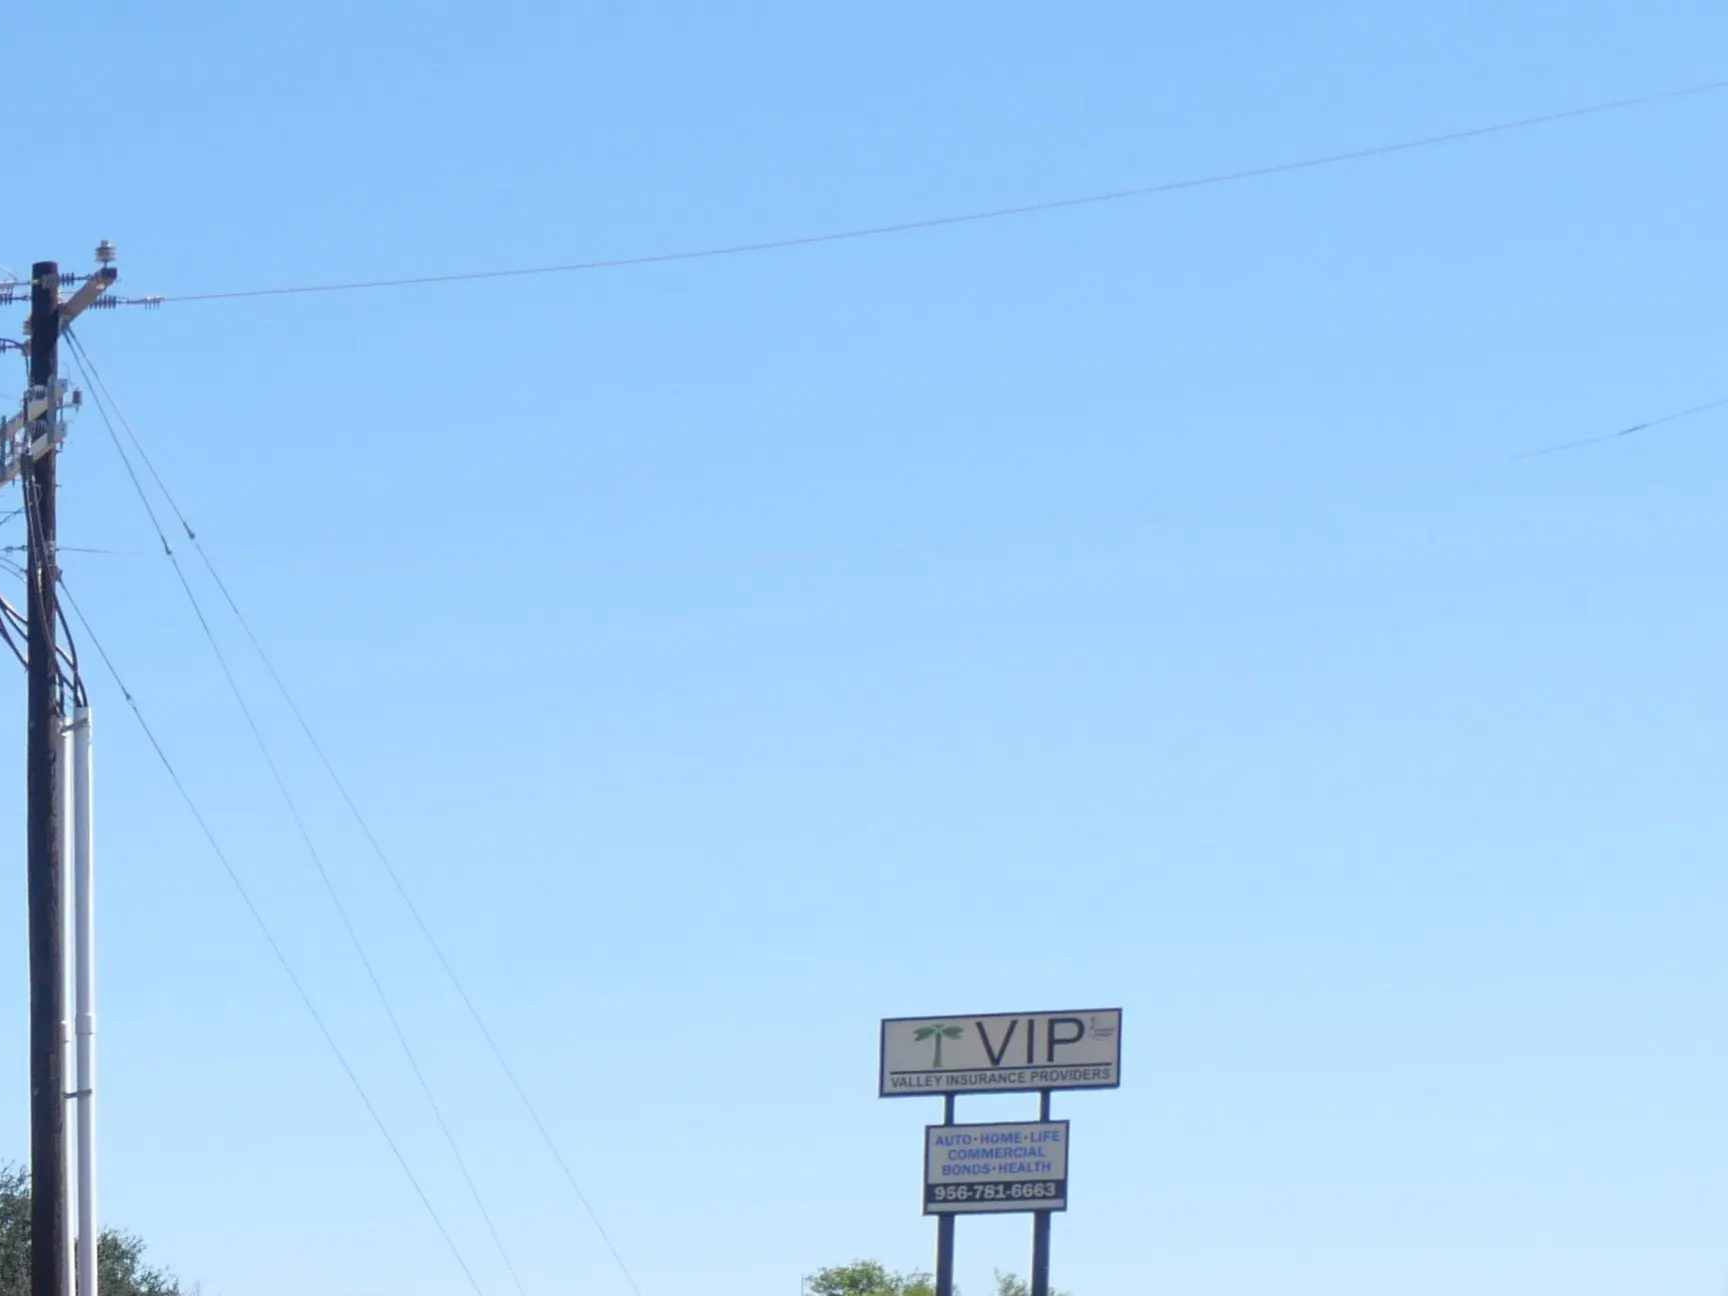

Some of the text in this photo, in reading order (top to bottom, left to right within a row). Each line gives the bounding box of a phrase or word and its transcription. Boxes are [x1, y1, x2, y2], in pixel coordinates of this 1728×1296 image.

[975, 1017, 1085, 1066] VIP
[891, 1068, 1111, 1088] VALLEY INSURANCE PROVIDERS
[935, 1130, 1061, 1146] AUTO HOME LIFE
[948, 1146, 1046, 1160] COMMERCIAL
[942, 1161, 1051, 1176] BONDS HEALTH
[934, 1182, 1056, 1200] 956-781-6663
